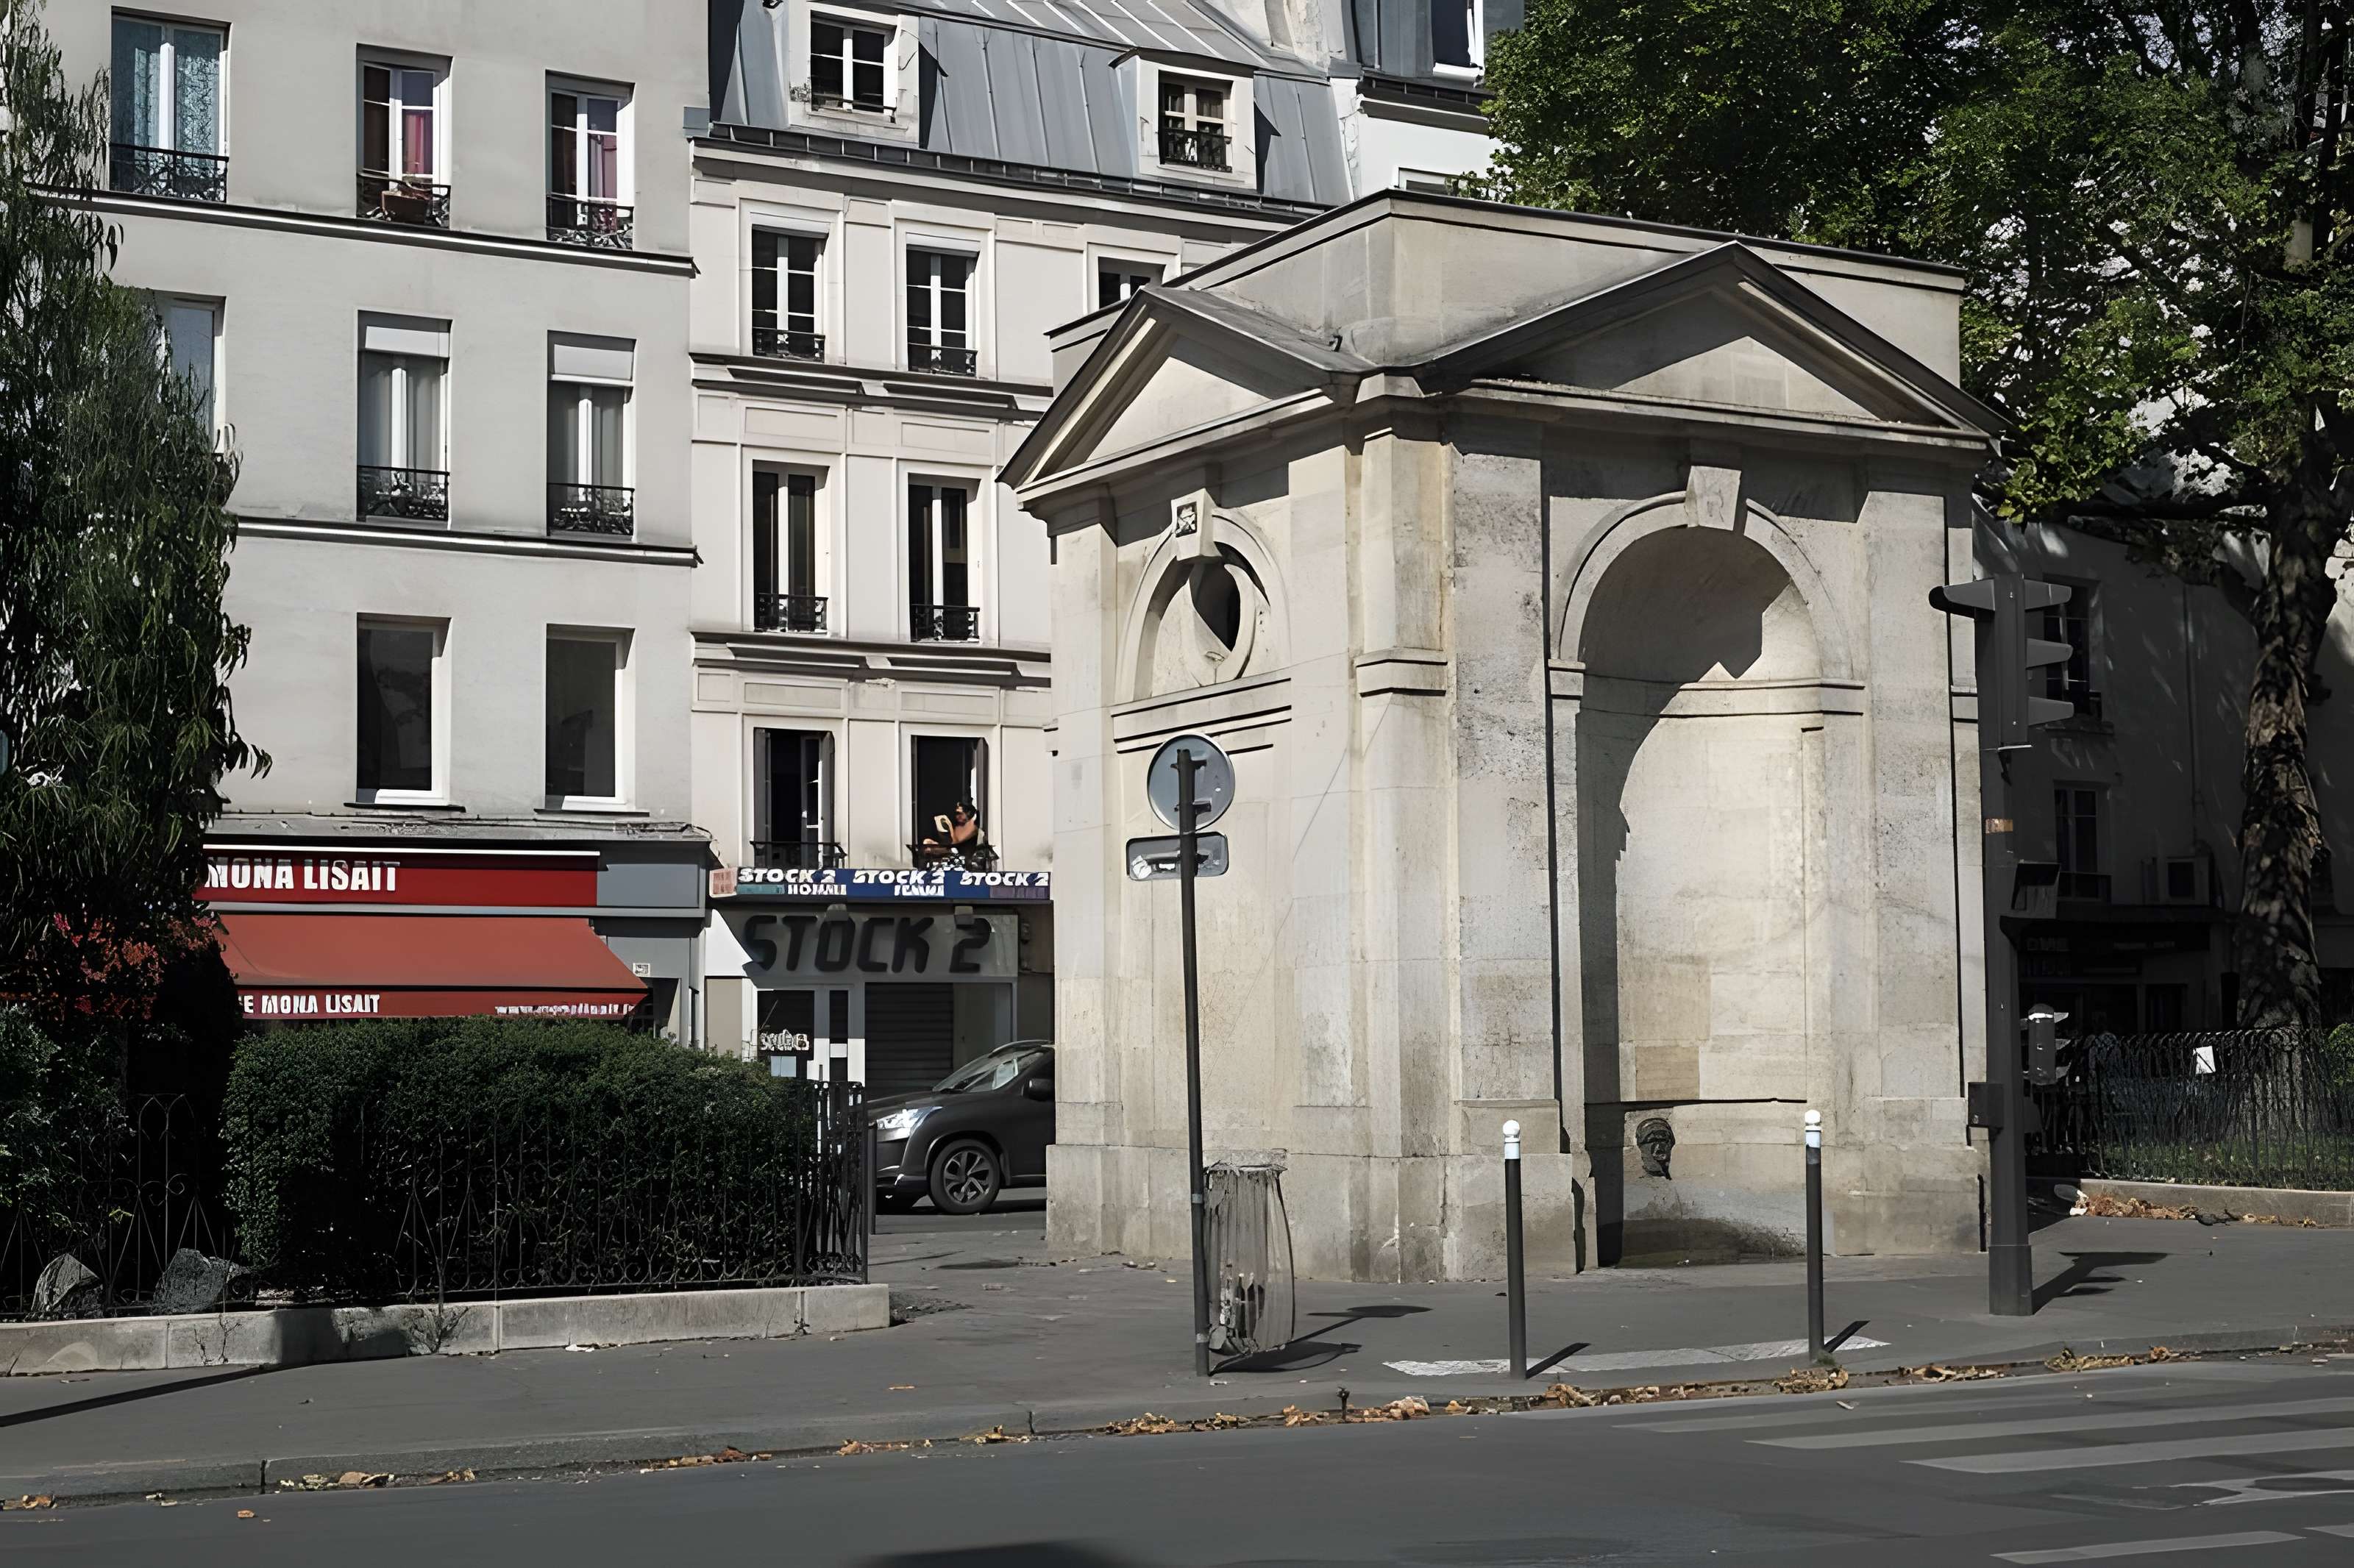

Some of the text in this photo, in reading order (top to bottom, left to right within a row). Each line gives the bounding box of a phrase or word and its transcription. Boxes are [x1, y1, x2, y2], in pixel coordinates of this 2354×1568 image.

[205, 857, 401, 891] MONA LISAIT
[738, 868, 814, 883] STOCK
[820, 869, 836, 883] 2
[853, 870, 945, 884] STOCK 2
[959, 872, 1049, 886] STOCK 2
[744, 914, 992, 973] STOCK 2
[261, 994, 319, 1013] MONA
[325, 994, 380, 1013] LISAIT
